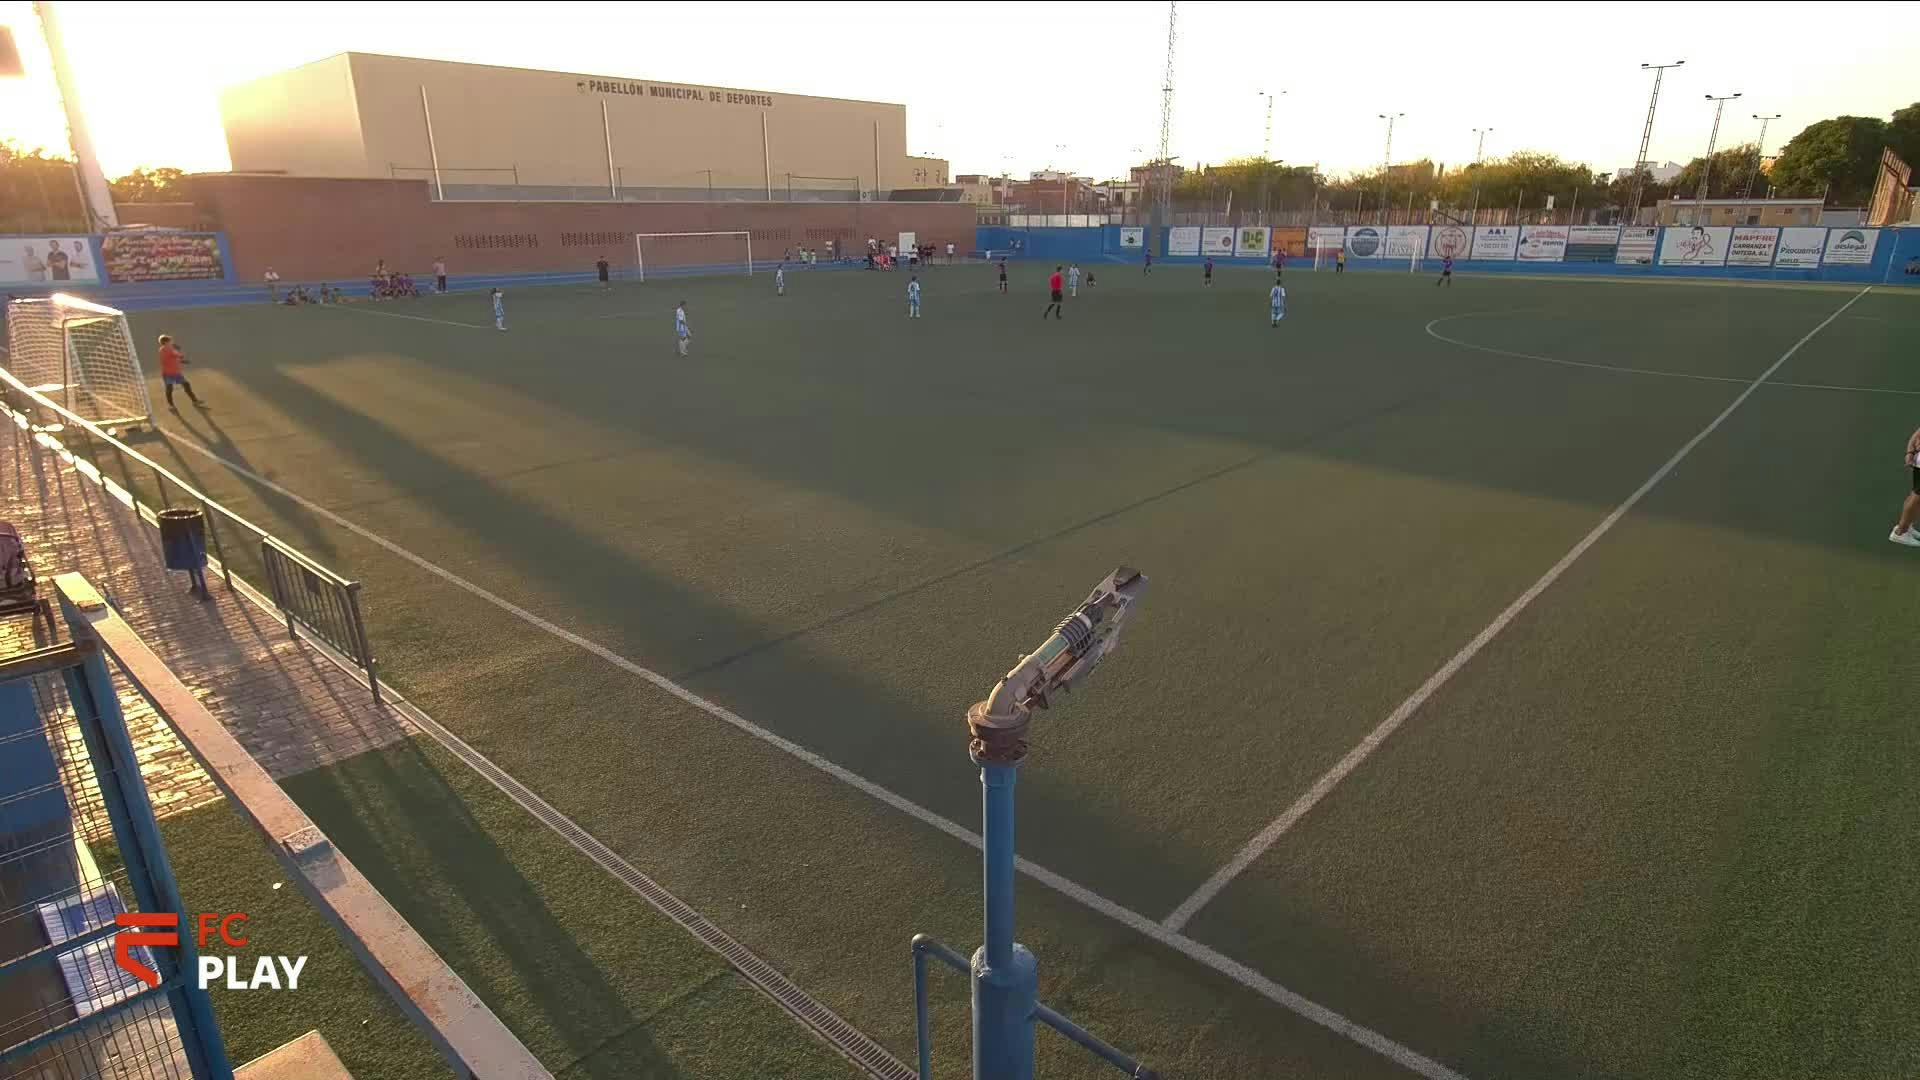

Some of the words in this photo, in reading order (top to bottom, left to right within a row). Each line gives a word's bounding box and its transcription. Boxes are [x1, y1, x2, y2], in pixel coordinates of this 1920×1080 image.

[650, 86, 704, 101] MUNICIPAL
[709, 91, 721, 102] DE
[727, 93, 772, 106] DEPORTES
